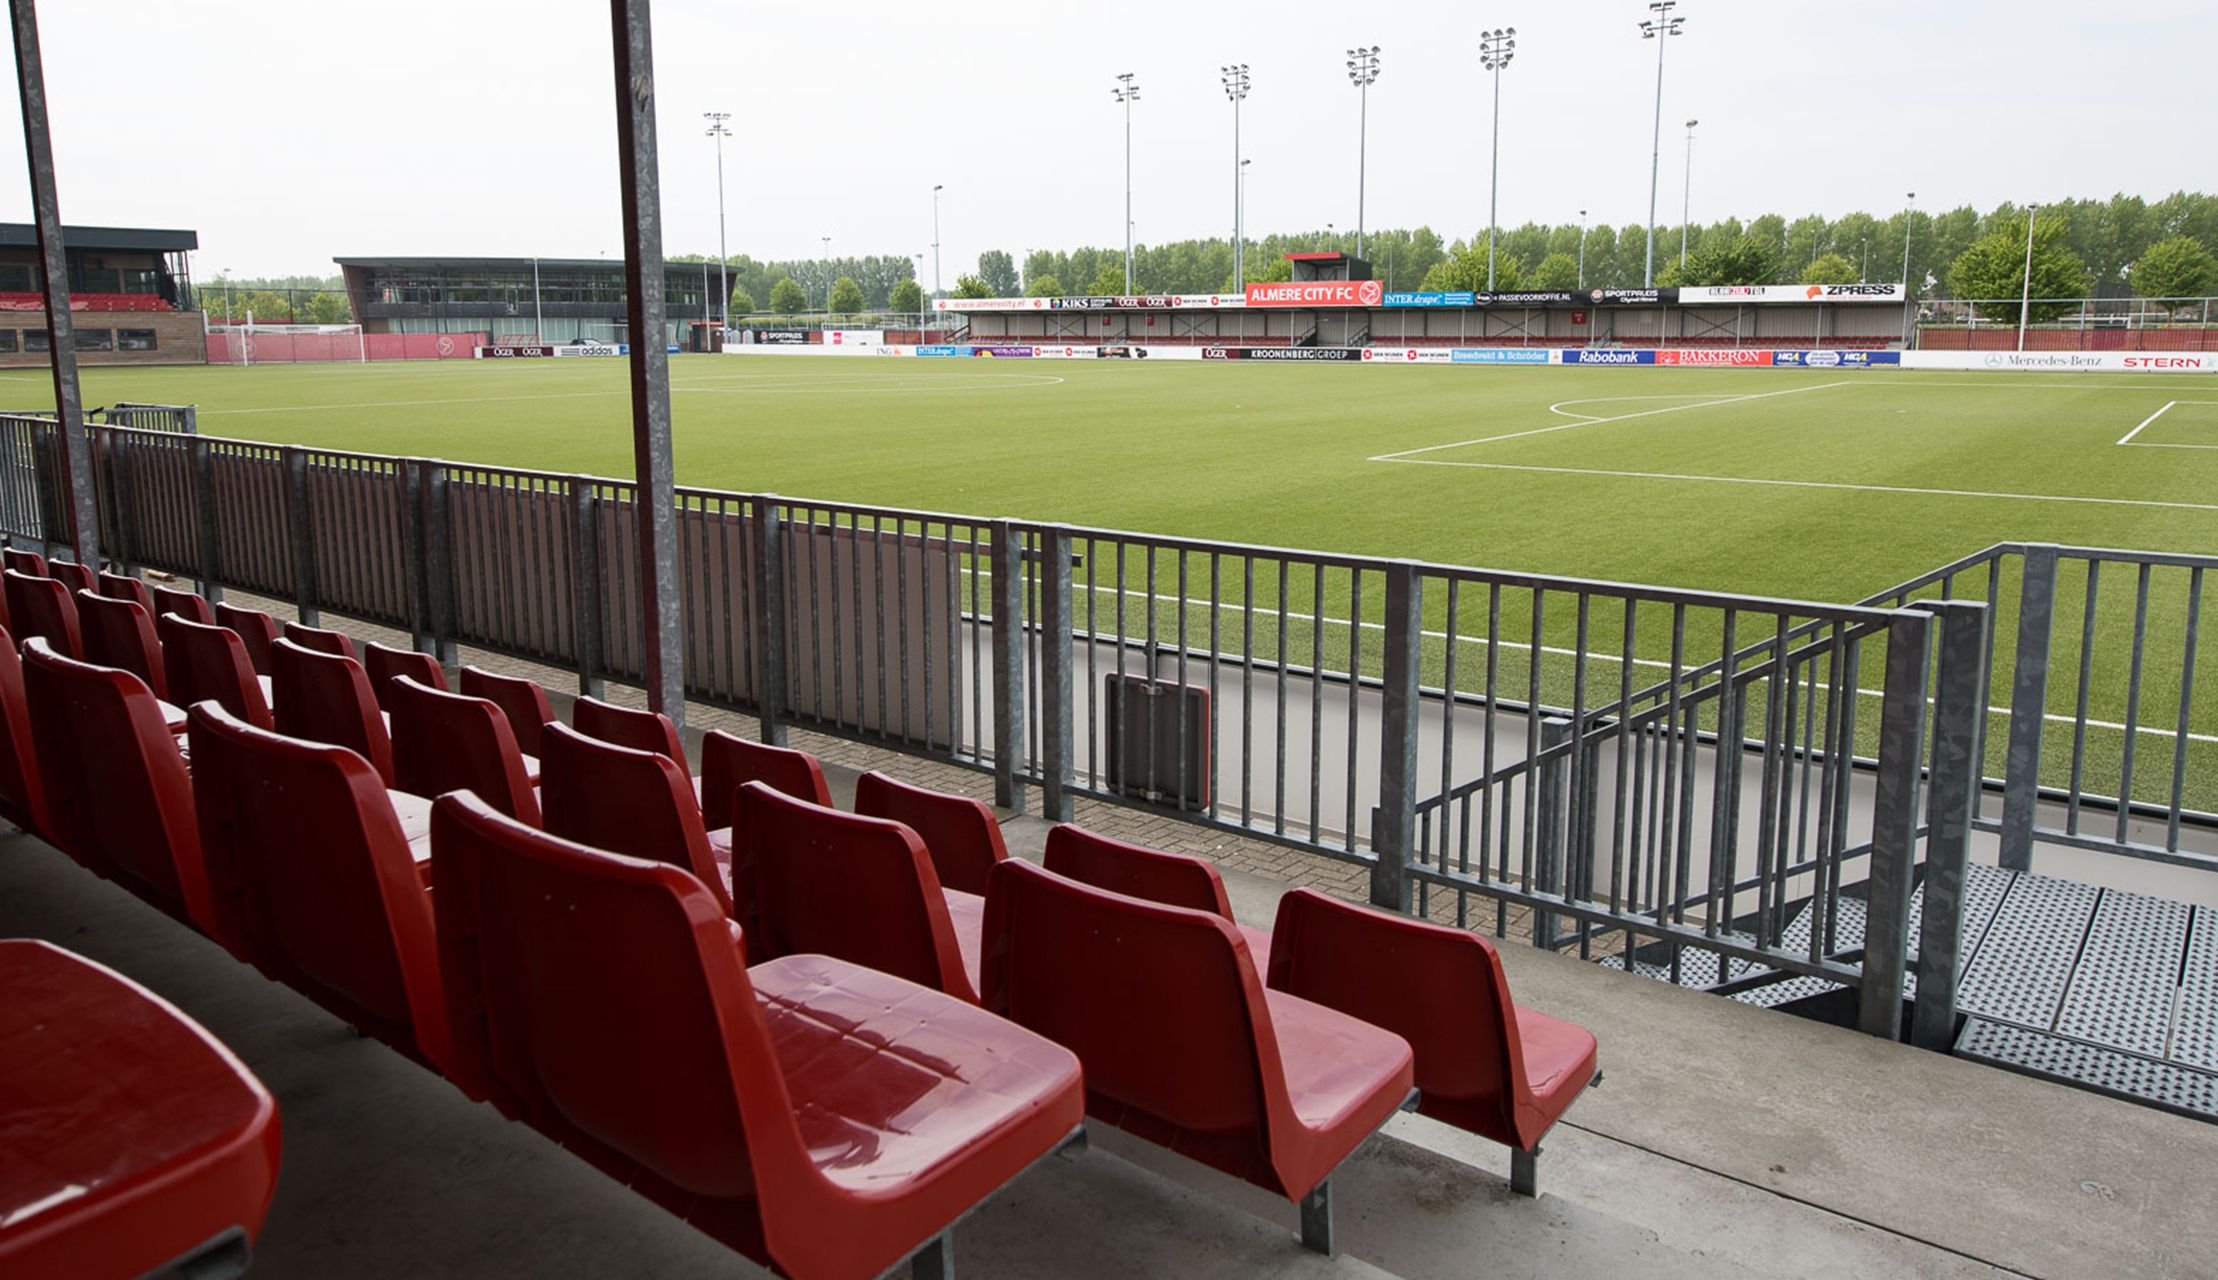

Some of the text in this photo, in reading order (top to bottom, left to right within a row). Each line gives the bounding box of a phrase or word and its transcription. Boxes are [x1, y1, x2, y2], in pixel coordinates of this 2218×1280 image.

[1252, 286, 1354, 302] ALMERE CITY FC
[1604, 289, 1659, 298] SPORTPALEIS
[1826, 286, 1896, 296] ZPRESS
[954, 299, 1025, 309] www.almerecity.nl
[1062, 298, 1089, 308] KIKS
[581, 346, 613, 356] adidas
[1251, 350, 1347, 359] KROONENBERG GROEP
[1579, 350, 1638, 363] Rabobank
[1679, 350, 1760, 363] BAKKERON
[2007, 354, 2103, 367] Mercedes-Benz
[2123, 357, 2201, 368] STERN
